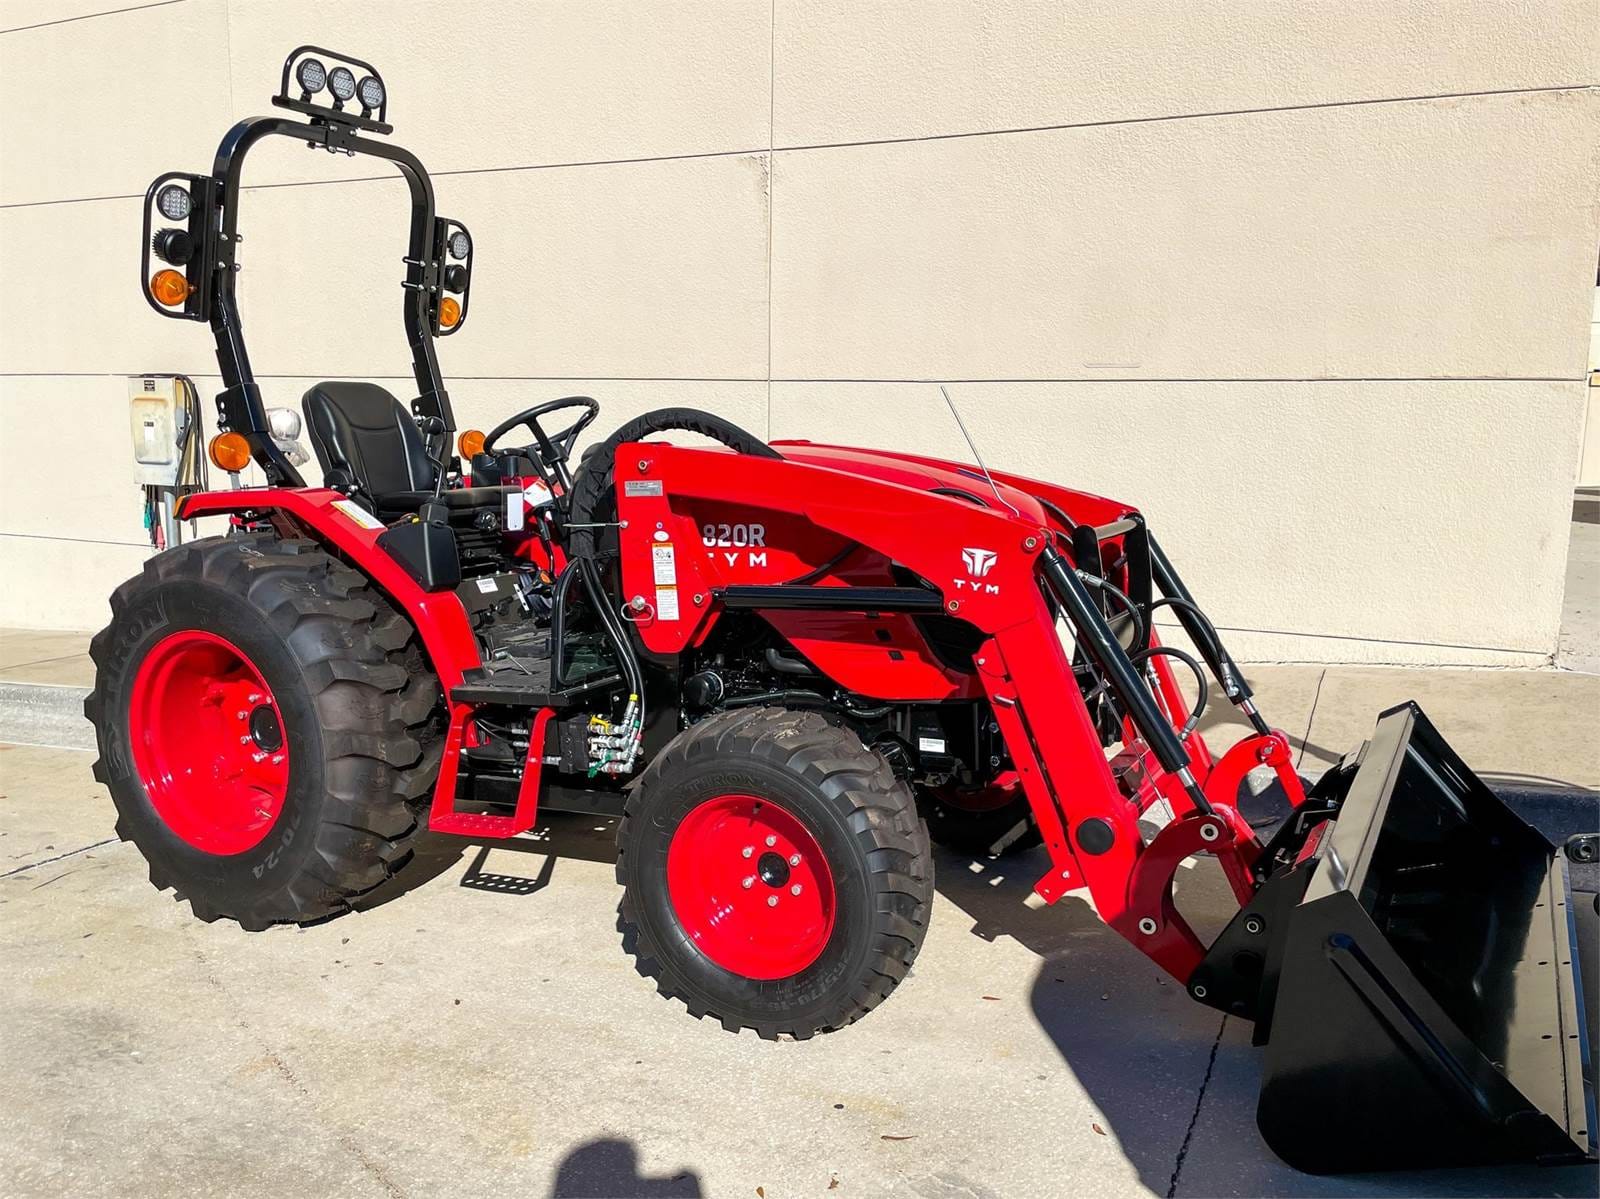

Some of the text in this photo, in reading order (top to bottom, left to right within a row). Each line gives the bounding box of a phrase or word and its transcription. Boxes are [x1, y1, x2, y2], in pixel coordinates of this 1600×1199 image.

[703, 524, 766, 547] 820R
[706, 552, 767, 567] YM
[953, 578, 1000, 595] TYM
